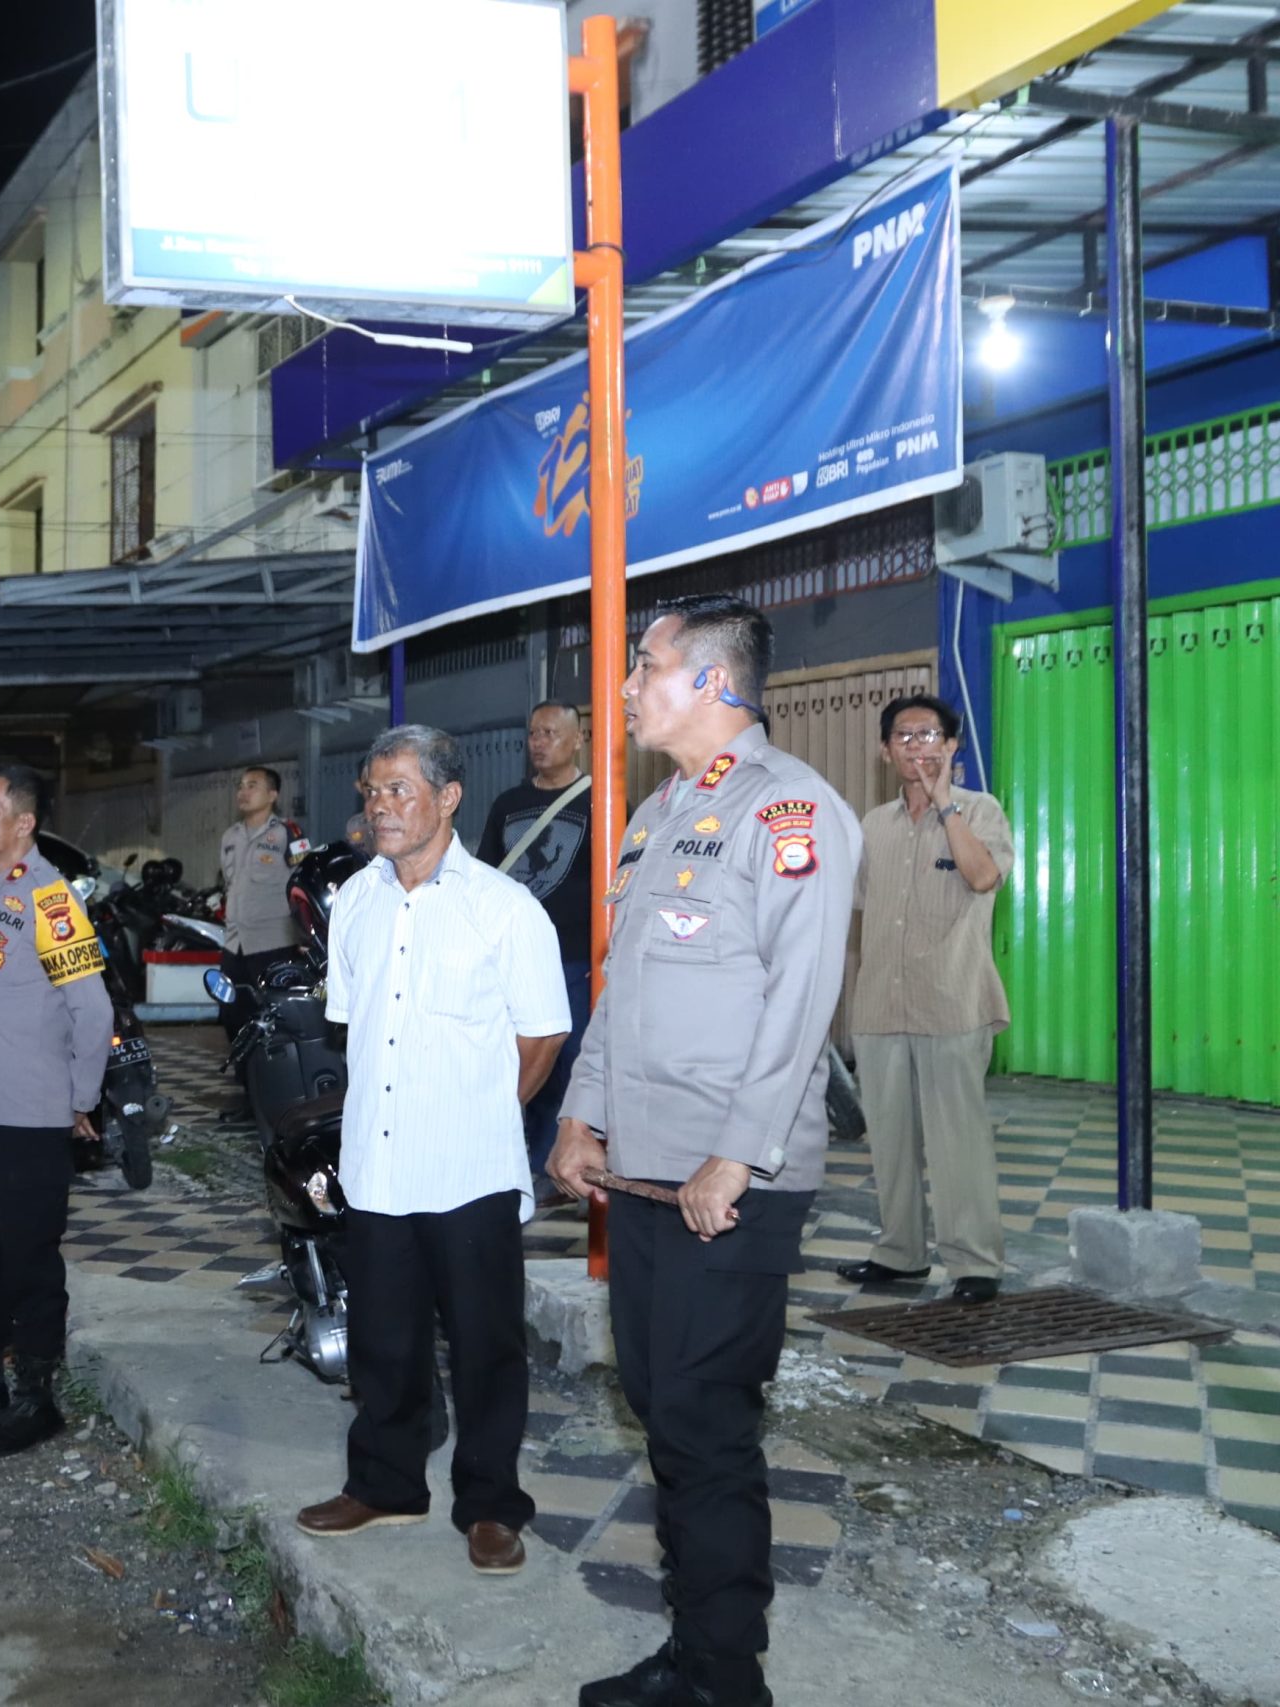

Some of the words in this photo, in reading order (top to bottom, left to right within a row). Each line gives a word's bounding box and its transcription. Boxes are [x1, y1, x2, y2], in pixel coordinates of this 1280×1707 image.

[853, 202, 926, 270] PNM
[818, 443, 846, 462] Holding
[846, 437, 865, 452] Ultra
[865, 428, 890, 445] Mikro
[891, 414, 936, 436] Indonesia
[895, 430, 939, 460] PNM
[762, 802, 812, 817] POLRES
[672, 839, 723, 857] POLRI
[67, 945, 90, 966] OPS
[131, 1040, 145, 1050] LS
